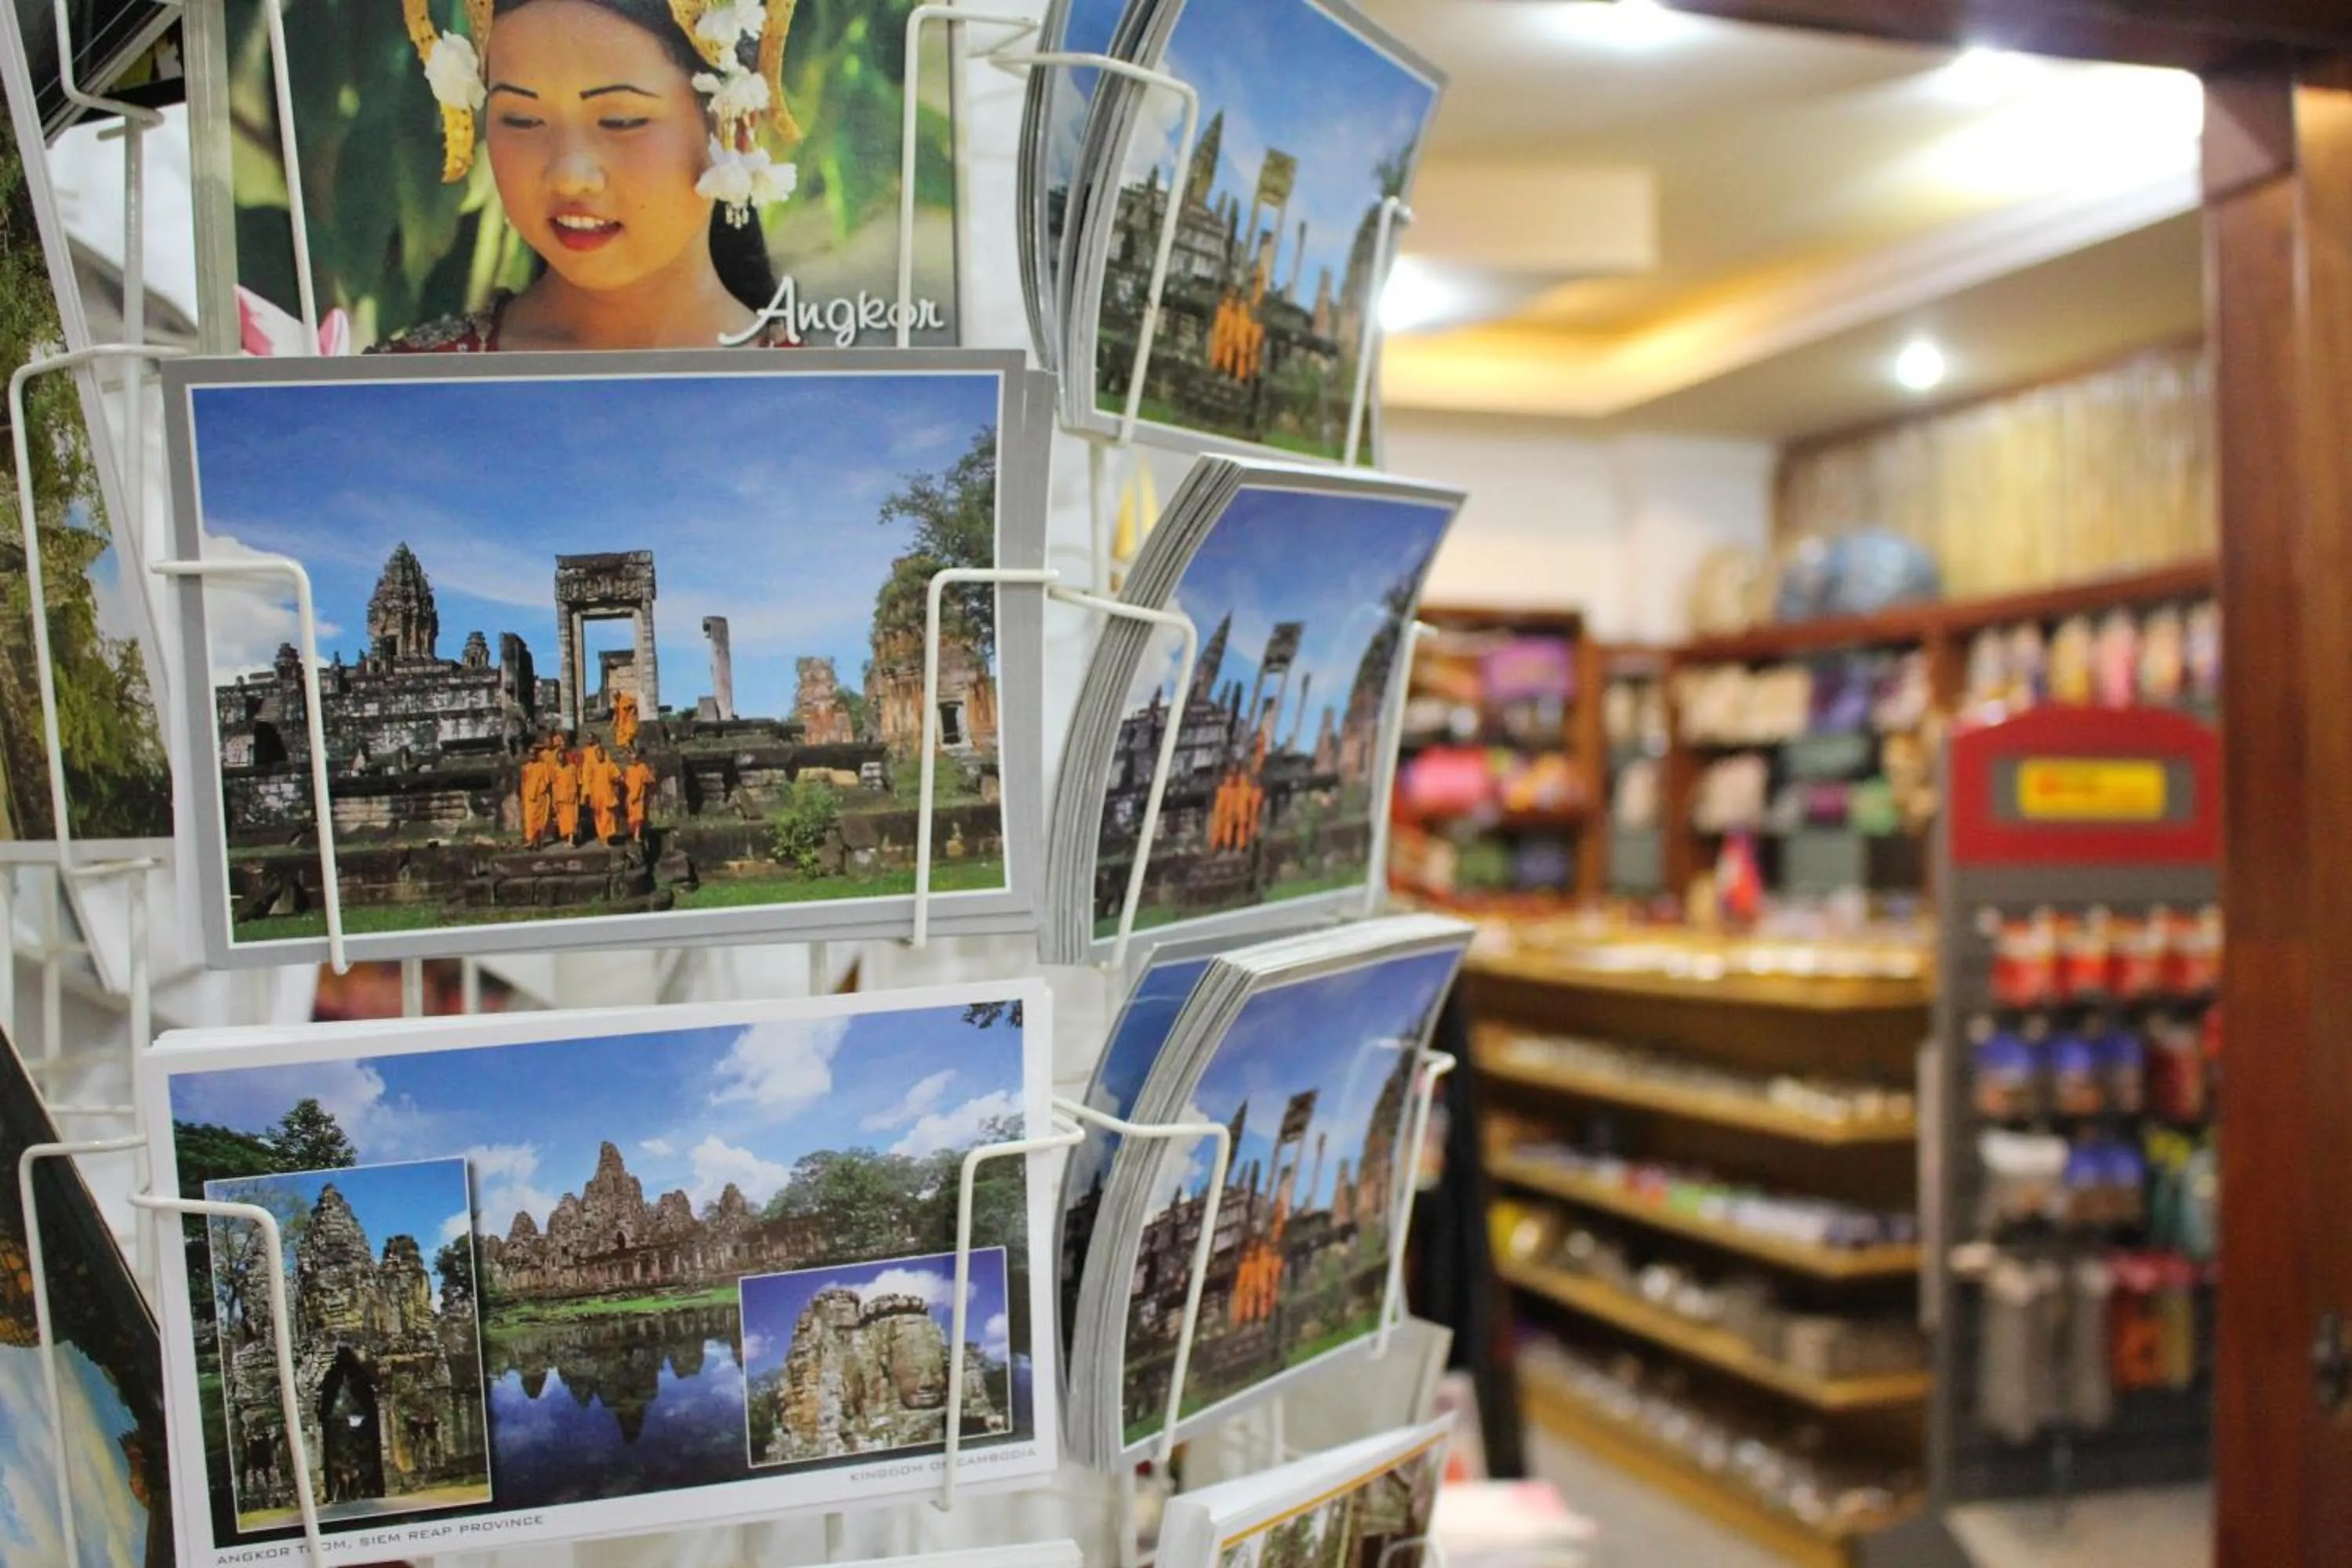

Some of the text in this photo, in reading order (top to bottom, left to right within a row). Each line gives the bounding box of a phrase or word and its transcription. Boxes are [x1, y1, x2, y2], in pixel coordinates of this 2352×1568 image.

[717, 275, 945, 347] Angkor
[850, 1465, 924, 1482] KINGDOM
[956, 1450, 1036, 1467] CAMBODIA
[217, 1548, 289, 1564] ANGKOR
[359, 1533, 401, 1548] SIEM
[408, 1526, 452, 1540] REAP
[459, 1515, 544, 1534] PROVINCE
